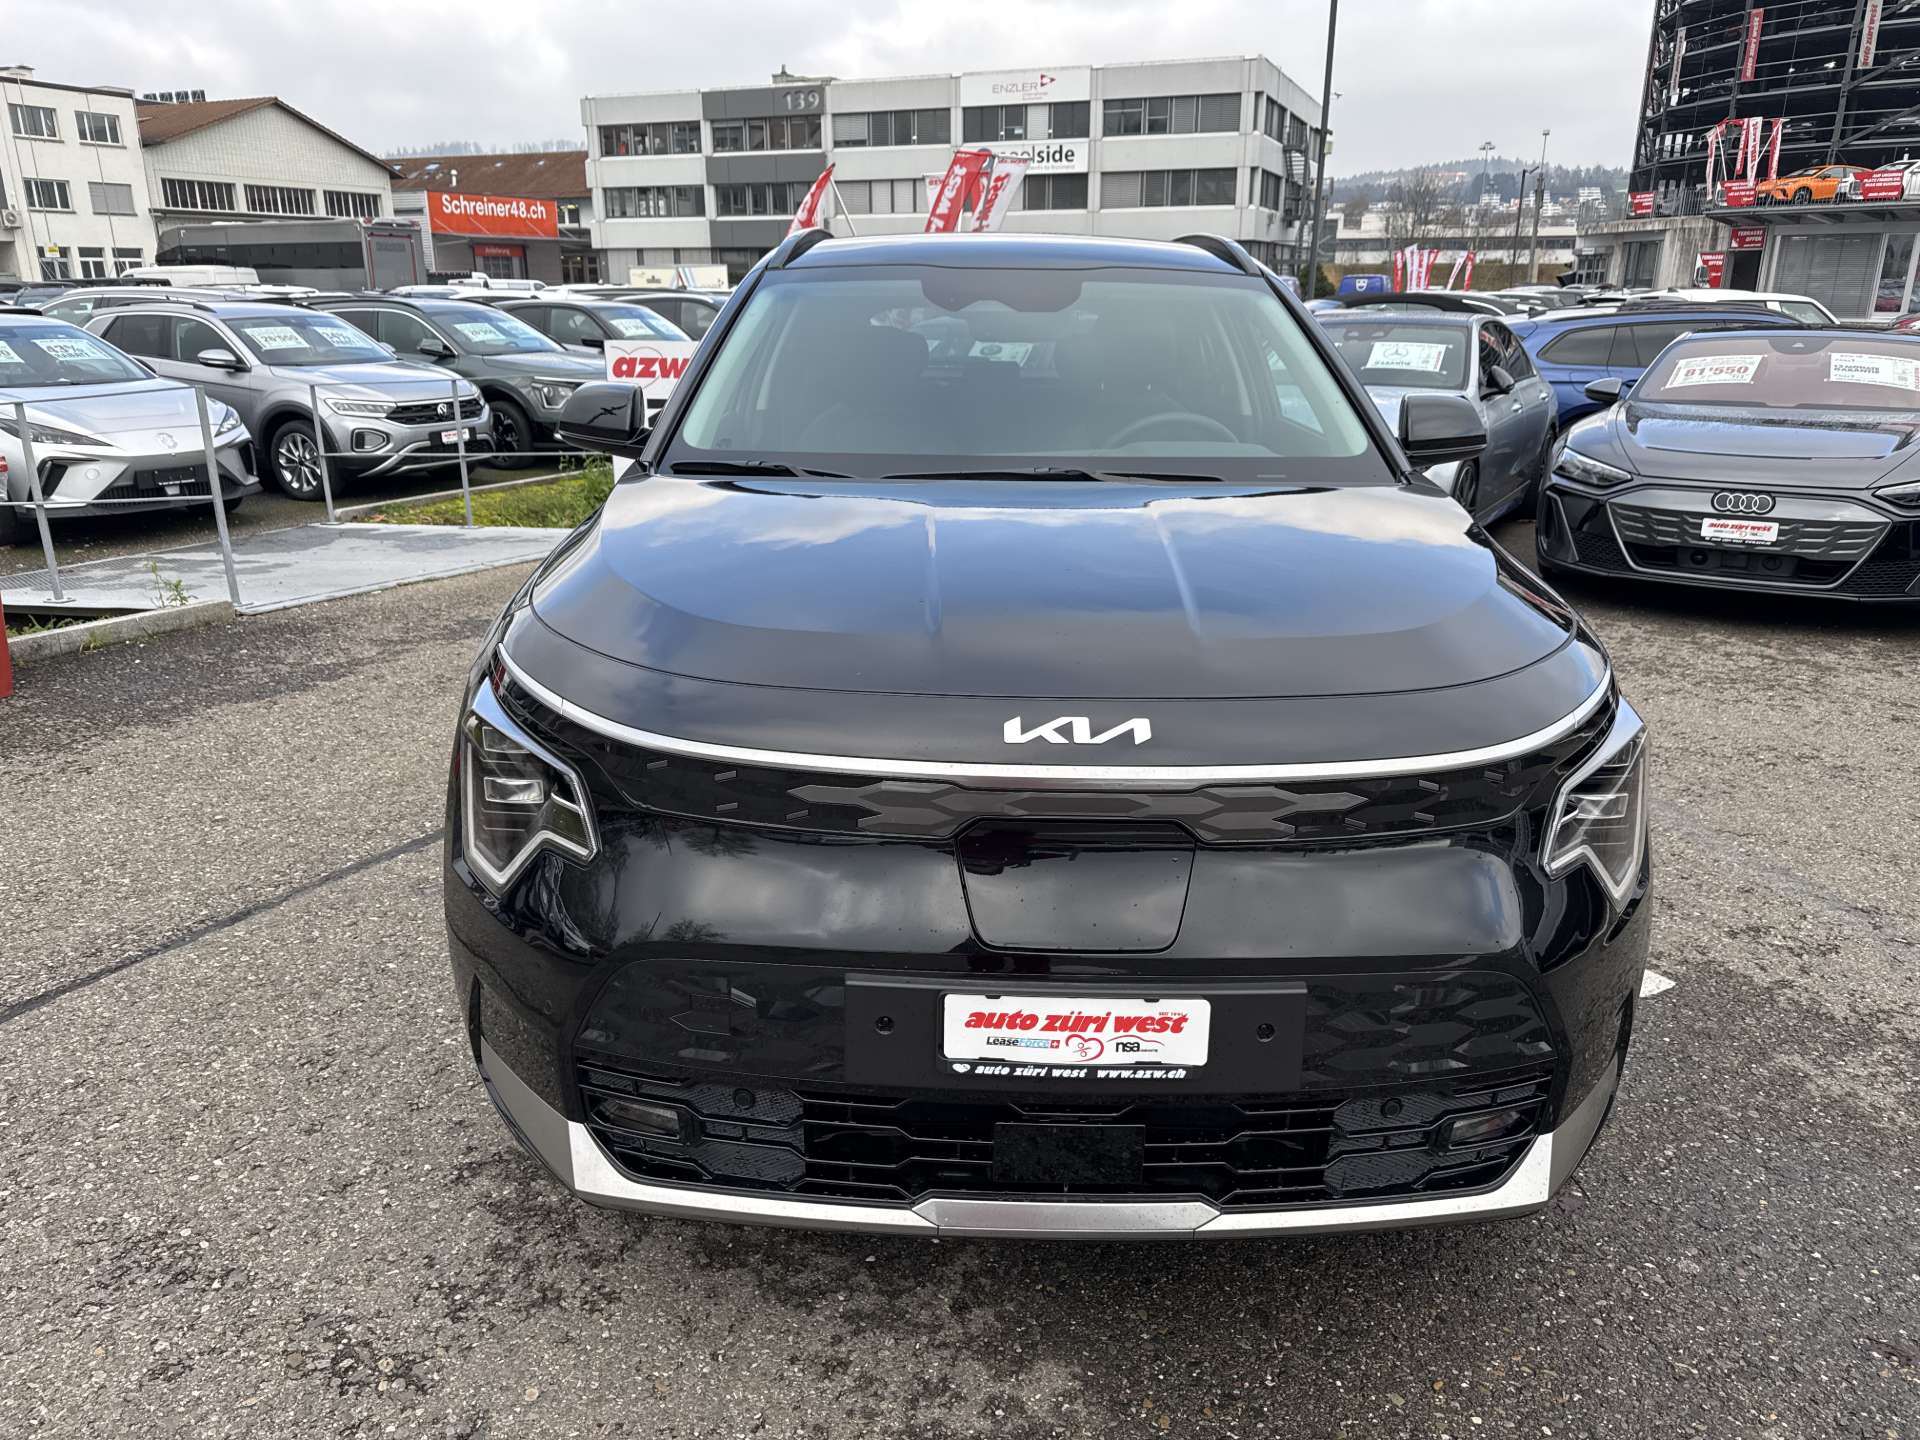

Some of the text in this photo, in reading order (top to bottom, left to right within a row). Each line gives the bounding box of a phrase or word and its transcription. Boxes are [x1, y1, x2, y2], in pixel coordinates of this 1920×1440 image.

[992, 82, 1038, 94] ENZLER
[784, 91, 819, 110] 139
[935, 164, 967, 214] west
[441, 193, 547, 219] Schreiner48.ch
[612, 356, 690, 379] azw
[1684, 365, 1749, 377] 81'550
[964, 1009, 1189, 1034] auto züri west
[986, 1036, 1050, 1049] LeaseForce
[1116, 1042, 1141, 1053] nsa
[975, 1064, 1187, 1080] auto züri west www.azw.ch
